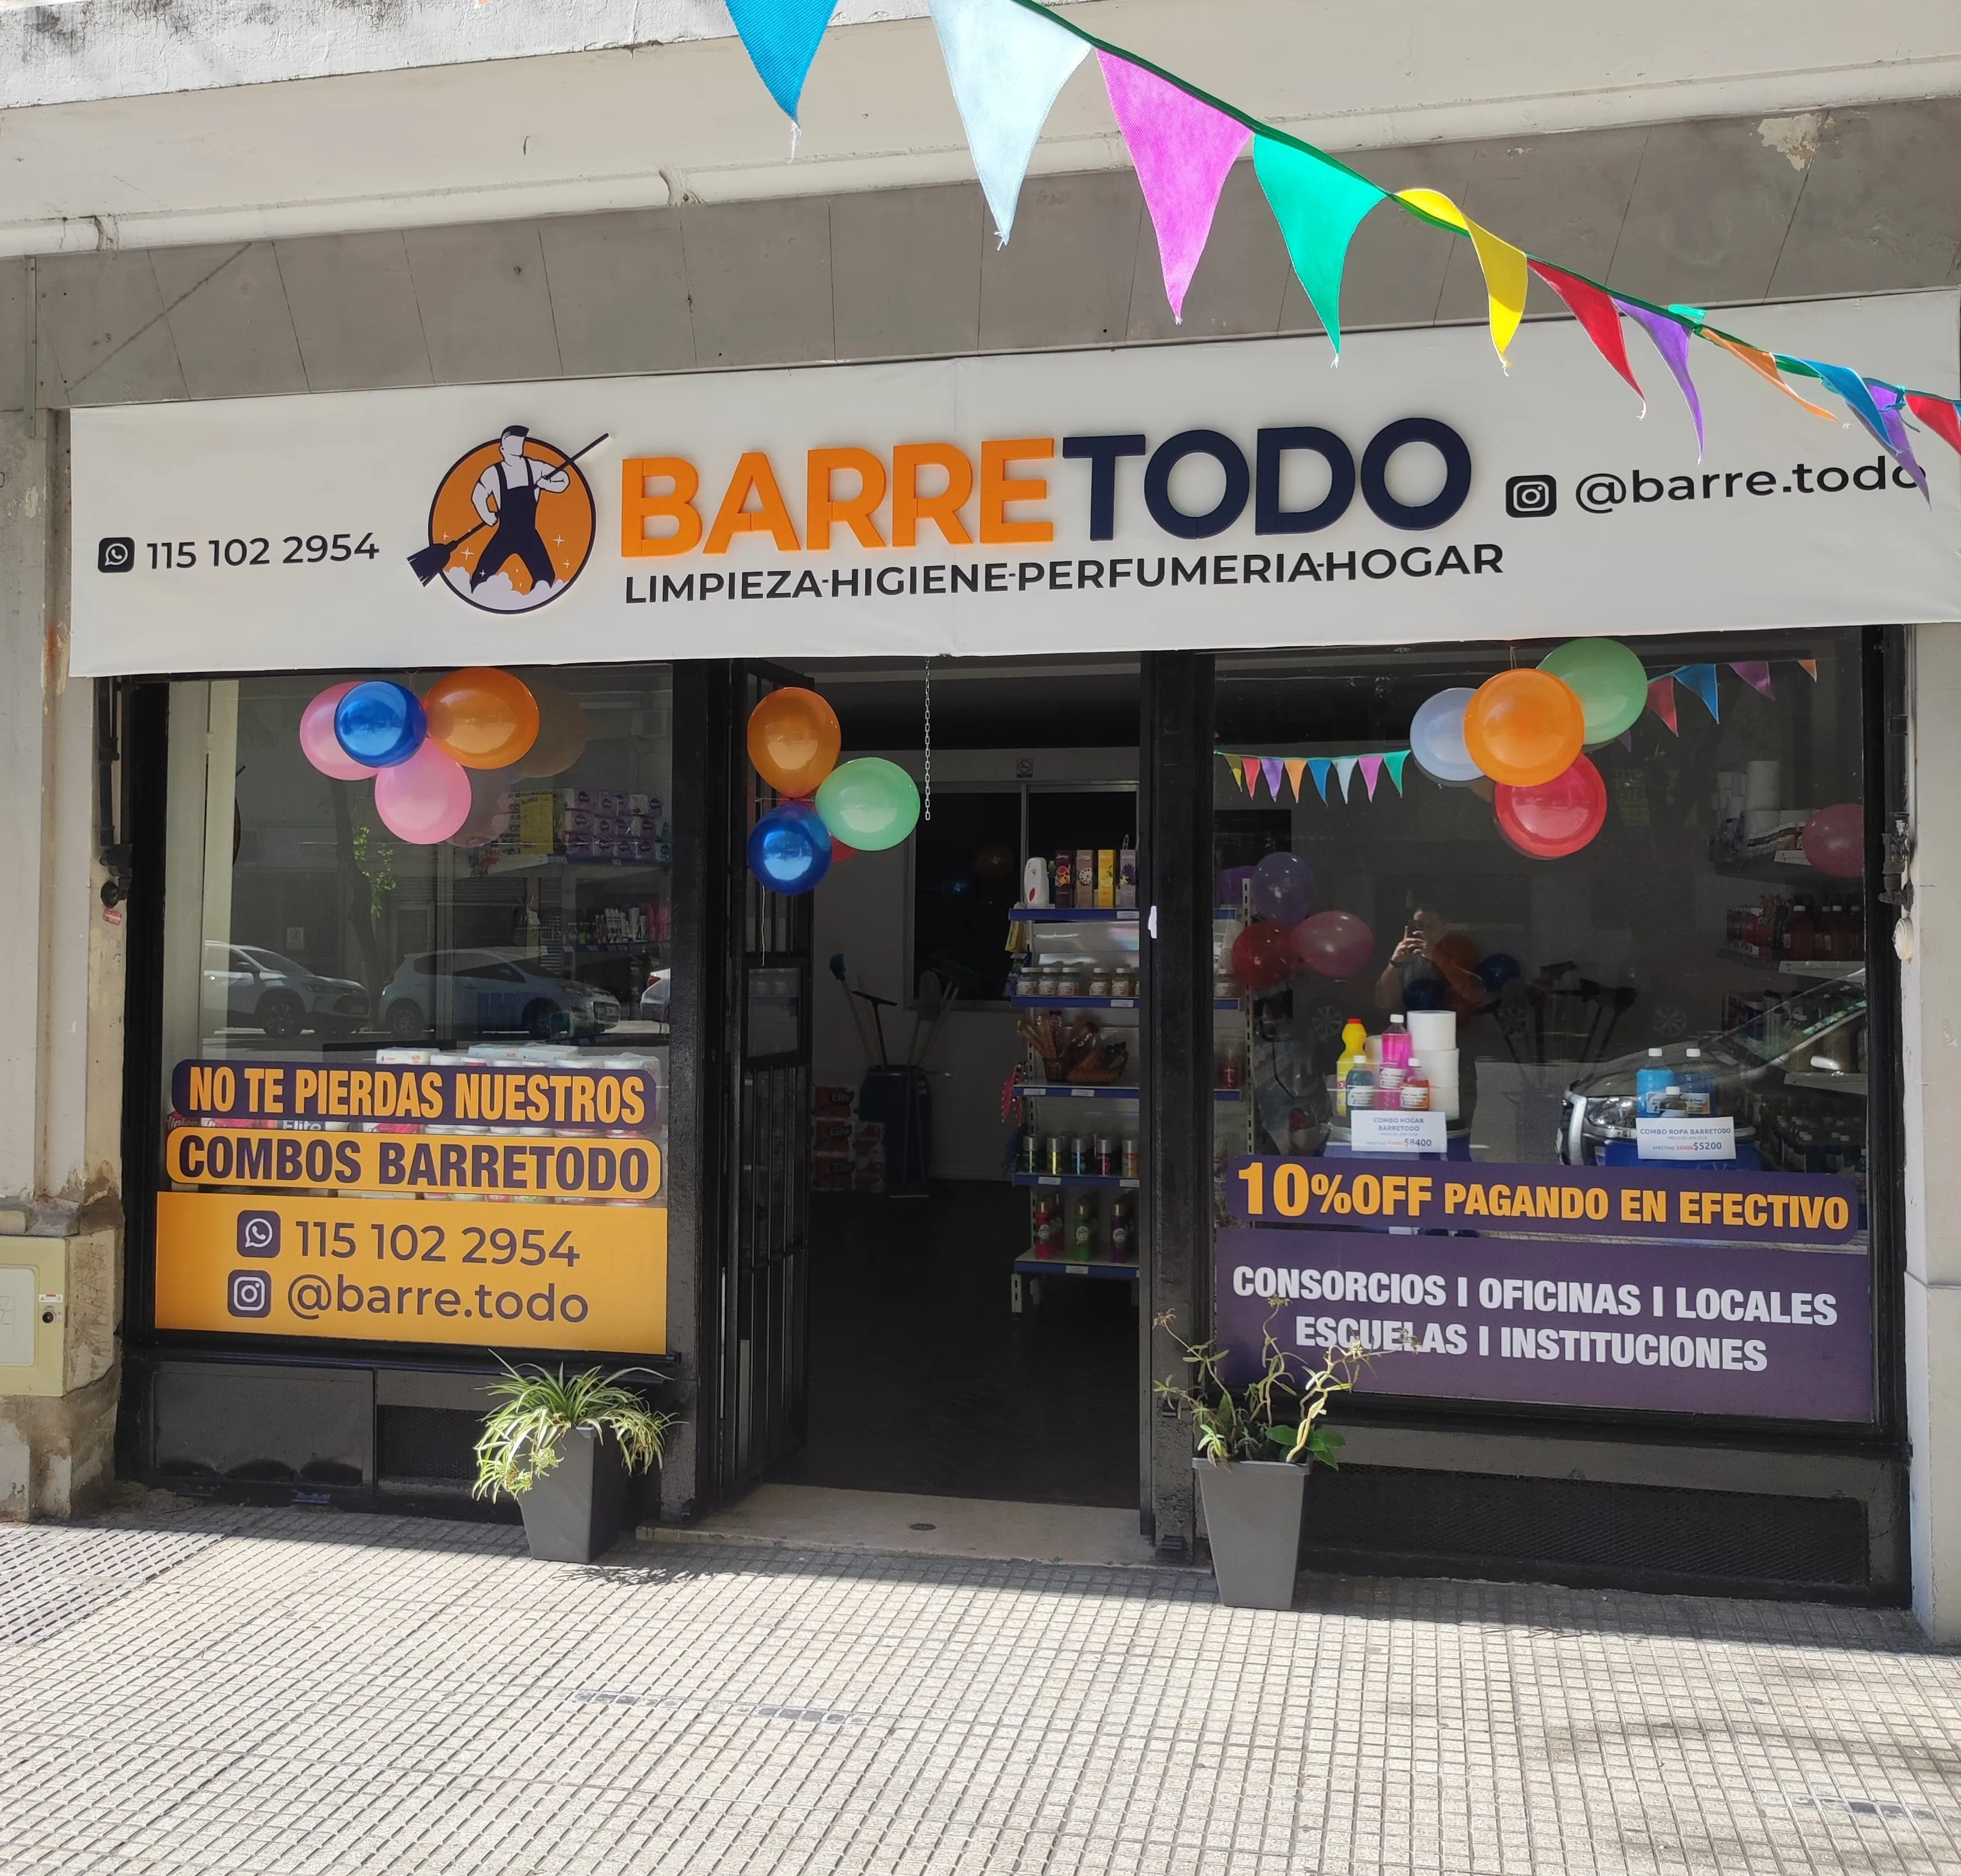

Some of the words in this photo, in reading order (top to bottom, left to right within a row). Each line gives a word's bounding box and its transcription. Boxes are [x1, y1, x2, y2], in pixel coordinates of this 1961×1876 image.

[620, 417, 1472, 558] BARRETODO
[1576, 455, 1928, 513] @barre.todo
[147, 542, 196, 569] 115
[209, 538, 269, 567] 102
[283, 533, 380, 563] 2954
[190, 1067, 235, 1112] NO
[245, 1068, 284, 1113] TE
[296, 1069, 443, 1118] PIERDAS
[456, 1074, 644, 1124] NUESTROS
[179, 1135, 361, 1183] COMBOS
[379, 1142, 649, 1192] BARRETODO
[1445, 1183, 1608, 1220] PAGANDO
[1622, 1189, 1667, 1222] EN
[1680, 1192, 1849, 1230] EFECTIVO
[296, 1221, 356, 1258] 115
[371, 1224, 446, 1261] 102
[462, 1227, 579, 1266] 2954
[288, 1274, 588, 1322] @barre.todo
[1234, 1266, 1446, 1306] CONSORCIOS
[1479, 1278, 1641, 1316] OFICINAS
[1676, 1287, 1837, 1325] LOCALES
[1296, 1316, 1467, 1356] ESCUELAS
[1501, 1327, 1767, 1371] INSTITUCIONES
